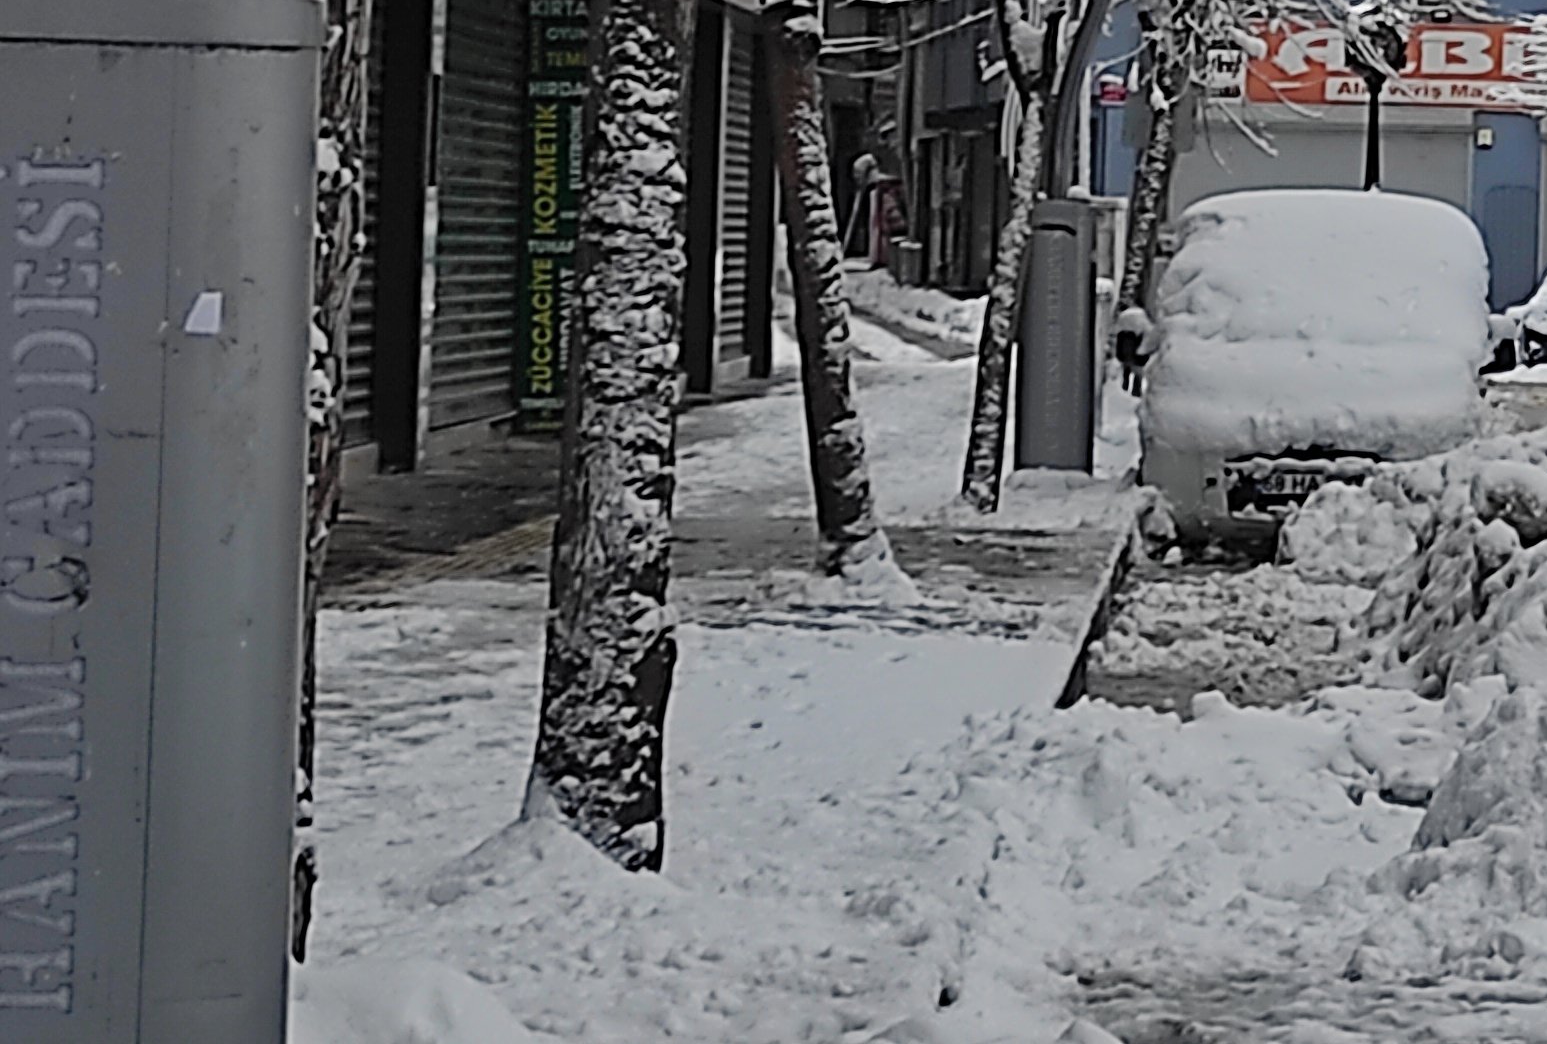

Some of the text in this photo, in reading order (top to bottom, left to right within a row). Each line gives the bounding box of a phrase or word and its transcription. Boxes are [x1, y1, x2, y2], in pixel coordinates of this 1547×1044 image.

[529, 104, 557, 234] KOZMETİK
[527, 259, 553, 394] ZÜCCACİYE
[0, 158, 103, 1014] HANIM CADDESİ
